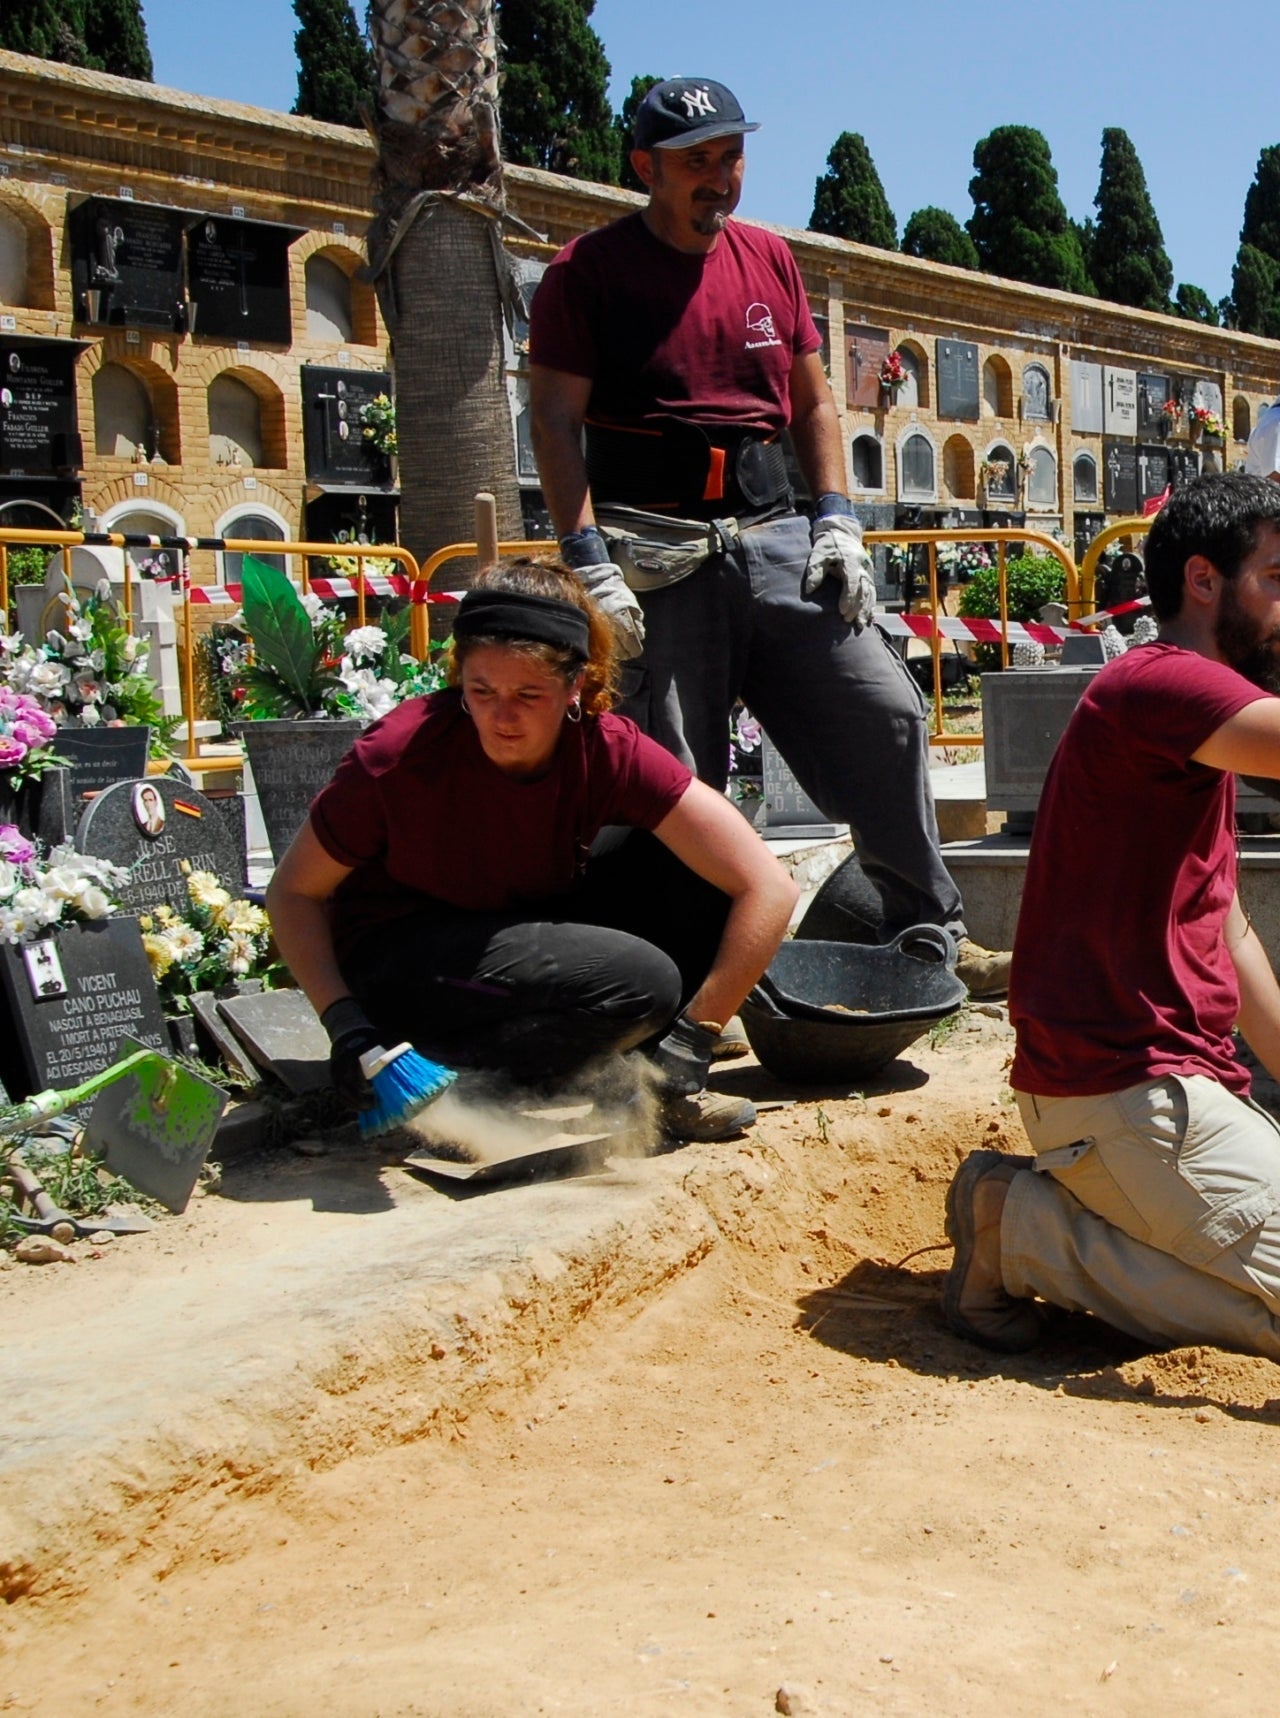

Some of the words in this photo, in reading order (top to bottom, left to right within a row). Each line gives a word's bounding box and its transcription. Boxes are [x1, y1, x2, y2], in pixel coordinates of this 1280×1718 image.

[136, 835, 176, 859] JOSE
[172, 853, 217, 876] TRIN
[77, 973, 117, 993] VICENT
[63, 996, 95, 1015] CANO
[97, 989, 142, 1010] PUCHAU
[48, 1017, 84, 1033] NASCUT
[86, 1015, 94, 1027] A
[94, 1007, 145, 1026] BENAGUASIL
[60, 1034, 66, 1046] I
[65, 1030, 91, 1046] MORT
[92, 1029, 100, 1041] A
[100, 1022, 138, 1041] PATERNA
[46, 1051, 59, 1064] EL
[59, 1042, 108, 1062] 20/5/1940
[61, 1058, 108, 1077] DESCANSA
